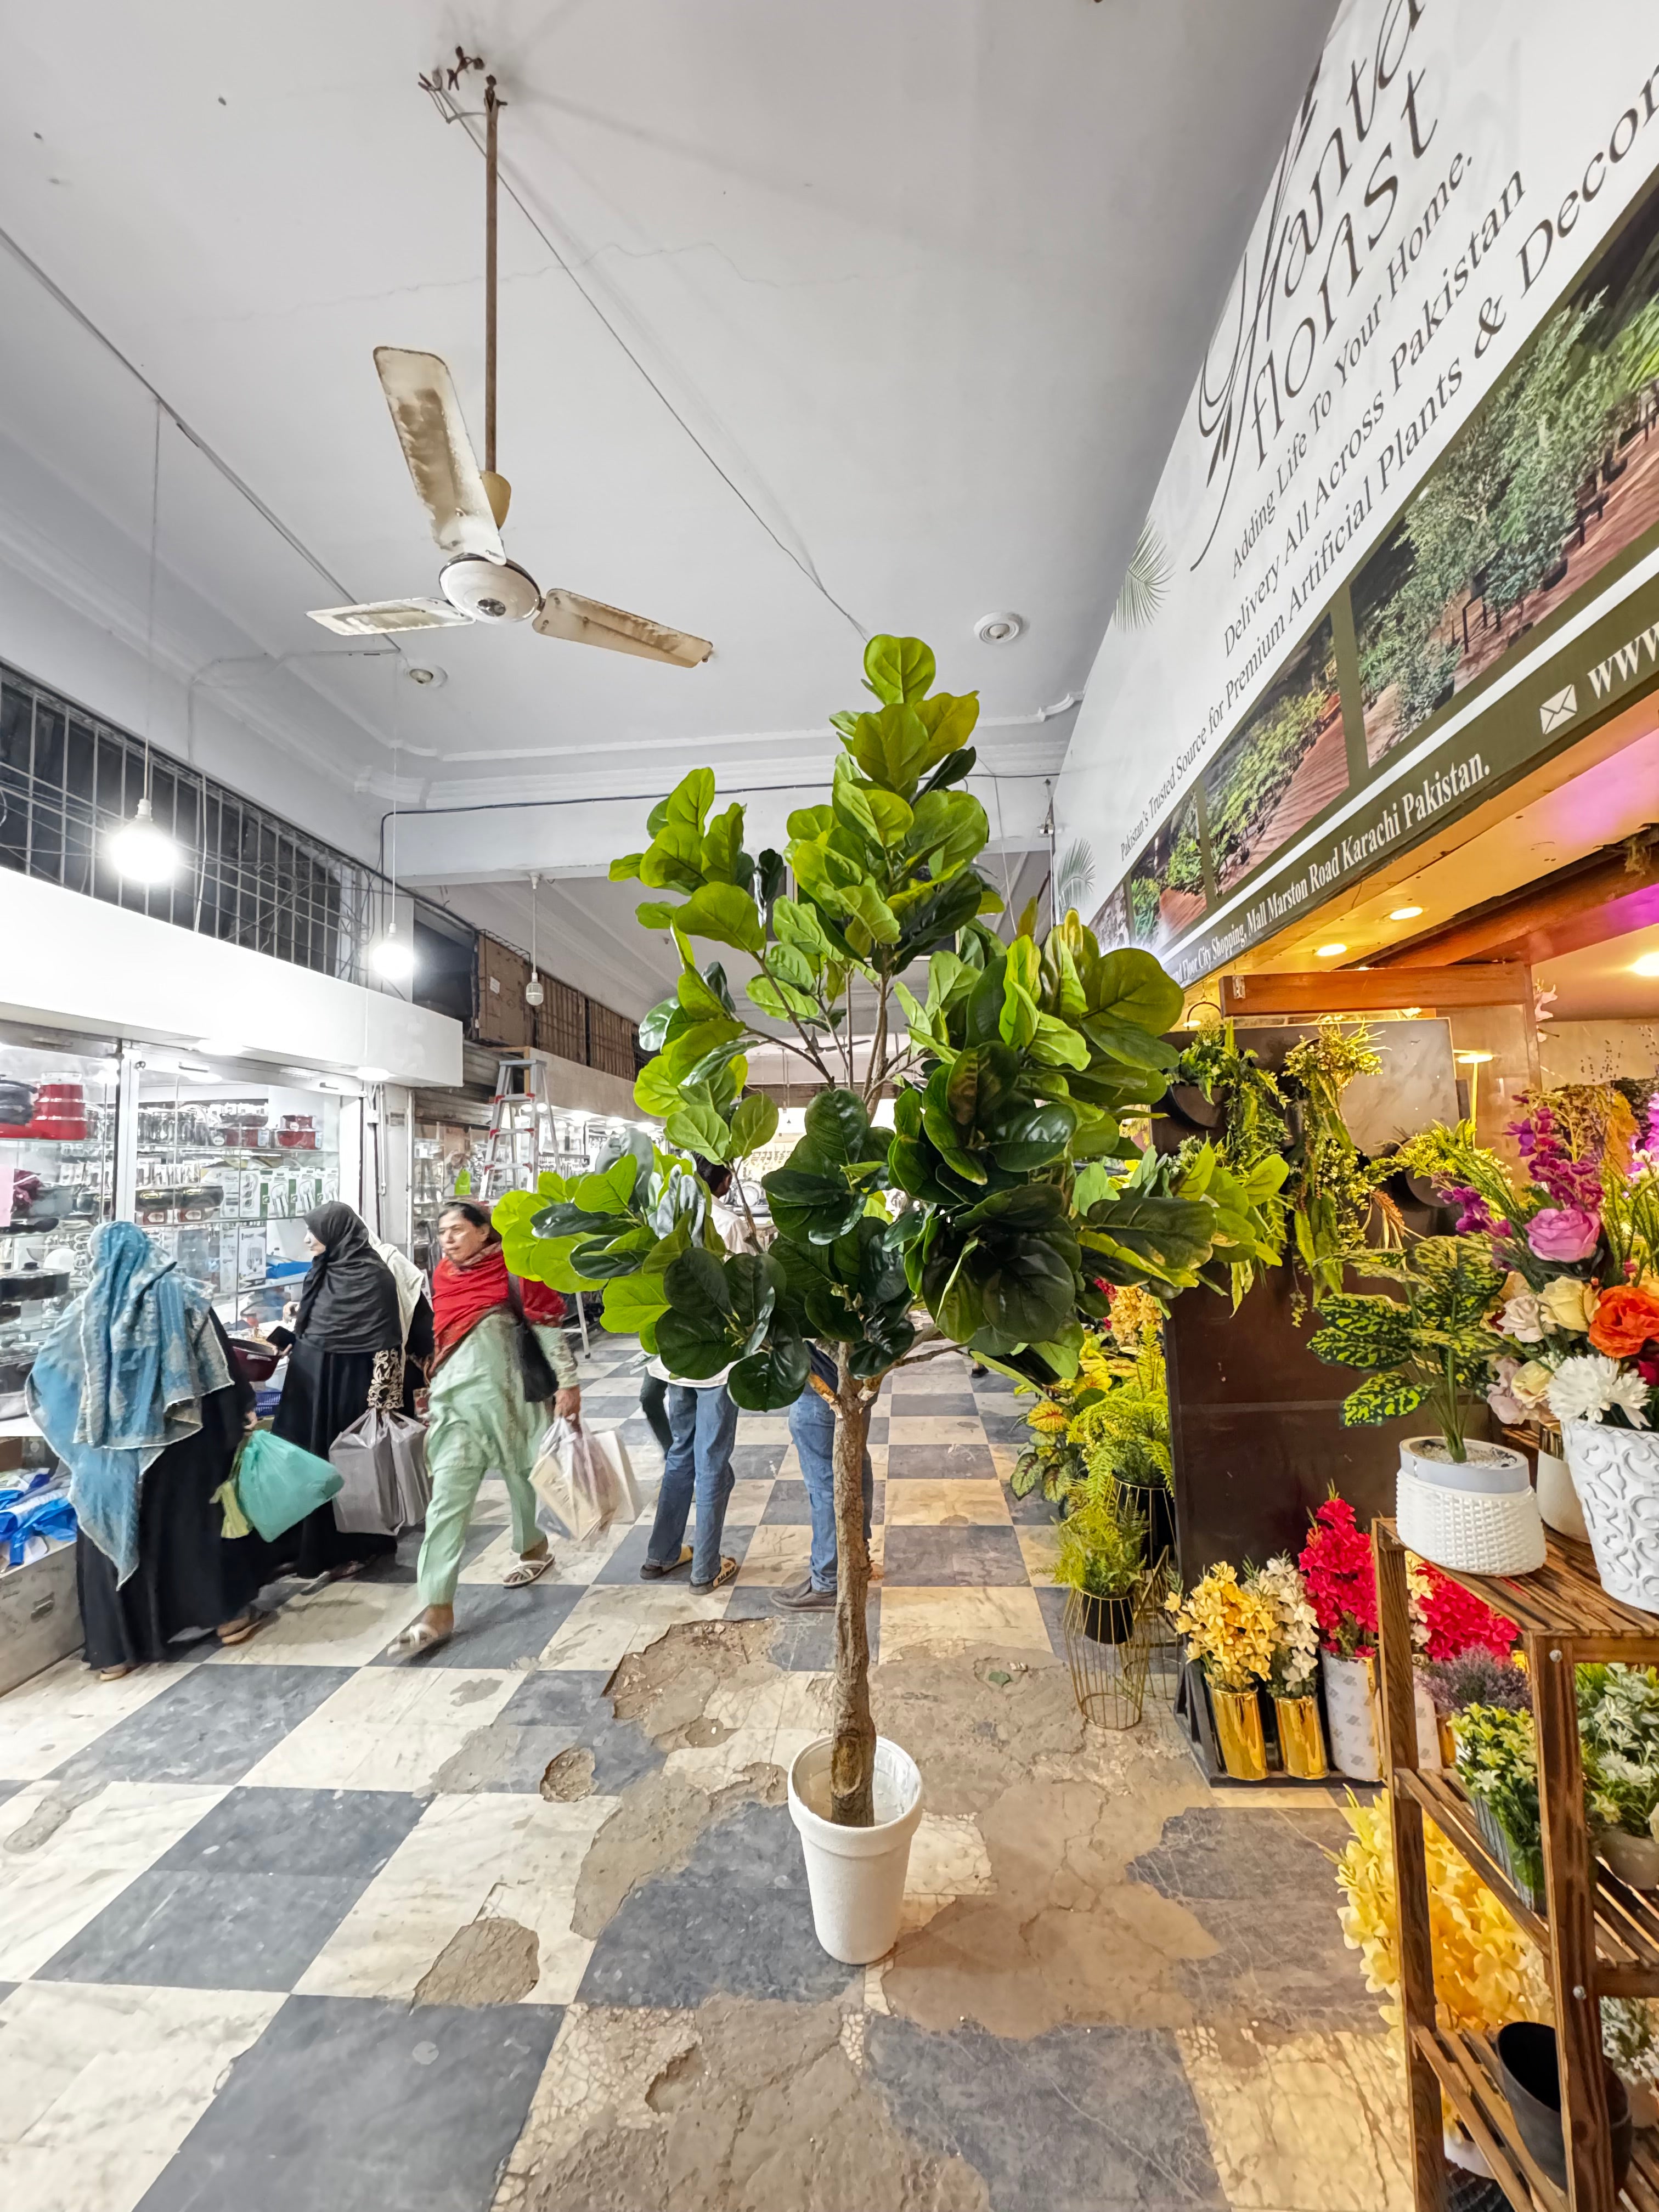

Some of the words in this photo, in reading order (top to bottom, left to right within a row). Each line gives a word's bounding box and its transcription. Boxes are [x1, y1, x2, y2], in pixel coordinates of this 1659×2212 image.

[1120, 810, 1149, 862] Pakistan's
[1148, 766, 1176, 820] Trusted
[1176, 727, 1207, 781] Source
[1208, 699, 1224, 735] for
[1225, 614, 1285, 710] Premium
[1289, 475, 1373, 624] Artificial
[1377, 357, 1463, 495] Plants
[1474, 294, 1507, 359] &
[1224, 555, 1280, 658] Delivery
[1285, 500, 1310, 566] All
[1314, 390, 1385, 520] Across
[1389, 170, 1526, 397] Pakistan
[1233, 490, 1276, 579] Adding
[1276, 432, 1307, 498] Life
[1309, 390, 1331, 435] To
[1334, 294, 1382, 388] Your
[1386, 152, 1472, 302] Home.
[1198, 945, 1211, 970] City
[1211, 922, 1248, 958] Shopping,
[1246, 901, 1267, 938] Mall
[1266, 878, 1308, 923] Marston
[1308, 847, 1340, 894] Road
[1341, 802, 1401, 872] Karachi
[1401, 753, 1491, 830] Pakistan.
